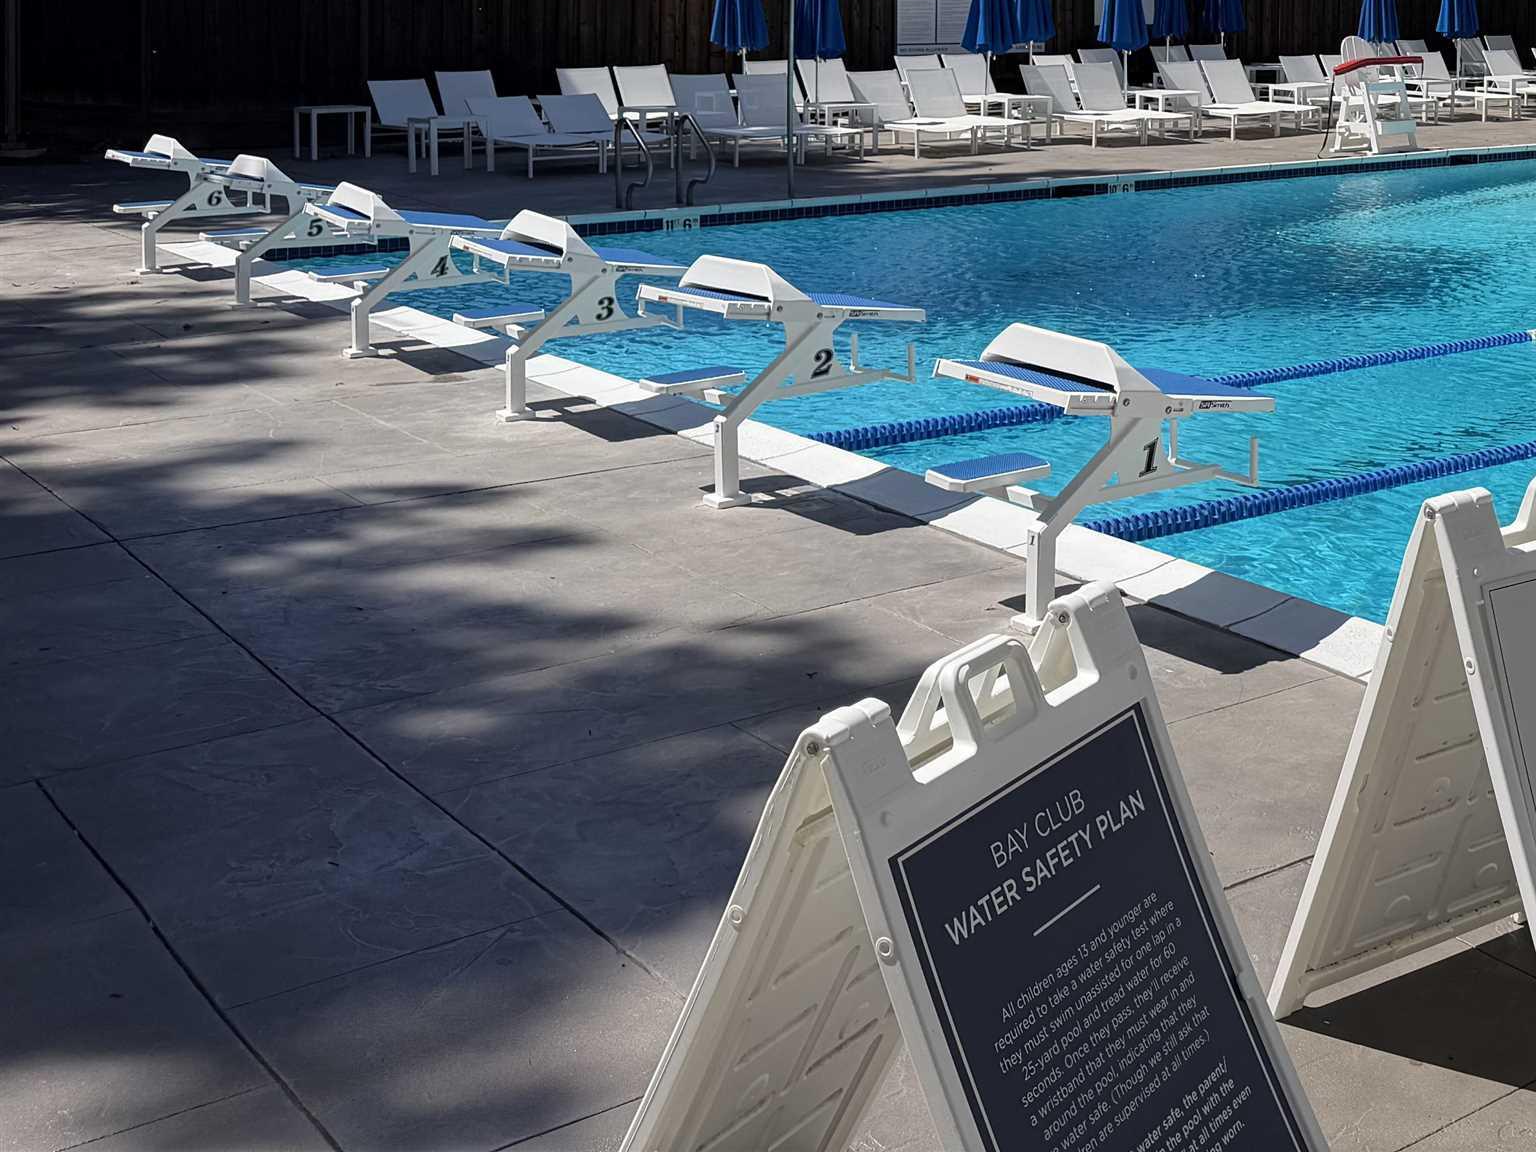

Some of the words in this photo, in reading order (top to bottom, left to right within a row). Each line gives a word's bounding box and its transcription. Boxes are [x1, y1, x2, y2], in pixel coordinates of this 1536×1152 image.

[207, 190, 223, 207] 6
[306, 218, 323, 237] 5
[430, 254, 449, 278] 4
[595, 295, 615, 321] 3
[810, 348, 834, 380] 2
[1138, 436, 1159, 478] 1
[943, 877, 1021, 945] WATER
[1021, 822, 1092, 892] SAFETY
[1094, 788, 1145, 840] PLAN
[989, 821, 1028, 868] BAY
[1034, 788, 1085, 837] CLUB
[993, 1009, 1036, 1053] required
[1035, 1003, 1048, 1018] to
[1047, 985, 1070, 1008] take
[1070, 979, 1078, 990] a
[1077, 957, 1103, 983] water
[1104, 935, 1131, 962] safety
[1130, 919, 1149, 940] test
[1148, 900, 1174, 925] where
[999, 1048, 1022, 1073] they
[1023, 1026, 1049, 1054] must
[1049, 1005, 1074, 1032] swim
[1074, 963, 1121, 1010] unassisted
[1120, 954, 1134, 971] for
[1135, 941, 1152, 960] one
[1150, 929, 1166, 946] lap
[1165, 922, 1175, 935] in
[1174, 916, 1182, 927] a
[1001, 1000, 1016, 1023] All
[1016, 973, 1055, 1009] children
[1055, 954, 1078, 978] ages
[1076, 942, 1088, 959] 13
[1089, 928, 1107, 951] and
[1106, 902, 1142, 939] younger
[1142, 891, 1157, 908] are
[1021, 1039, 1060, 1081] 25-yard
[1060, 1020, 1082, 1050] pool
[1082, 1004, 1101, 1029] and
[1100, 983, 1125, 1012] tread
[1124, 965, 1149, 991] water
[1149, 953, 1162, 970] for
[1162, 941, 1176, 959] 60
[1021, 1066, 1065, 1107] seconds.
[1063, 1042, 1090, 1068] Once
[1089, 1023, 1110, 1047] they
[1110, 1005, 1134, 1031] pass,
[1159, 955, 1189, 985] receive
[1029, 1114, 1038, 1126] a
[1037, 1067, 1085, 1118] wristband
[1084, 1051, 1105, 1076] that
[1104, 1034, 1125, 1058] they
[1125, 1013, 1148, 1039] must
[1148, 995, 1169, 1018] wear
[1169, 987, 1179, 1000] in
[1178, 970, 1195, 992] and
[1043, 1100, 1077, 1141] around
[1076, 1088, 1094, 1108] the
[1094, 1065, 1119, 1094] pool,
[1118, 1027, 1161, 1071] indicating
[1159, 1010, 1178, 1032] that
[1177, 994, 1196, 1016] they
[1059, 1119, 1087, 1150] water
[1088, 1101, 1111, 1125] safe.
[1147, 1050, 1162, 1068] we
[1162, 1032, 1178, 1055] still
[1177, 1021, 1193, 1041] ask
[1191, 1005, 1210, 1027] that
[1098, 1121, 1114, 1142] are
[1113, 1073, 1161, 1126] supervised
[1160, 1065, 1171, 1081] at
[1170, 1053, 1182, 1071] all
[1162, 1107, 1184, 1130] safe,
[1181, 1090, 1198, 1109] the
[1165, 1131, 1182, 1151] the
[1181, 1108, 1202, 1138] pool
[1200, 1092, 1221, 1115] with
[1218, 1078, 1234, 1096] the
[1197, 1125, 1210, 1145] all
[1208, 1104, 1233, 1133] times
[1232, 1085, 1251, 1109] even
[1220, 1119, 1245, 1145] worn.
